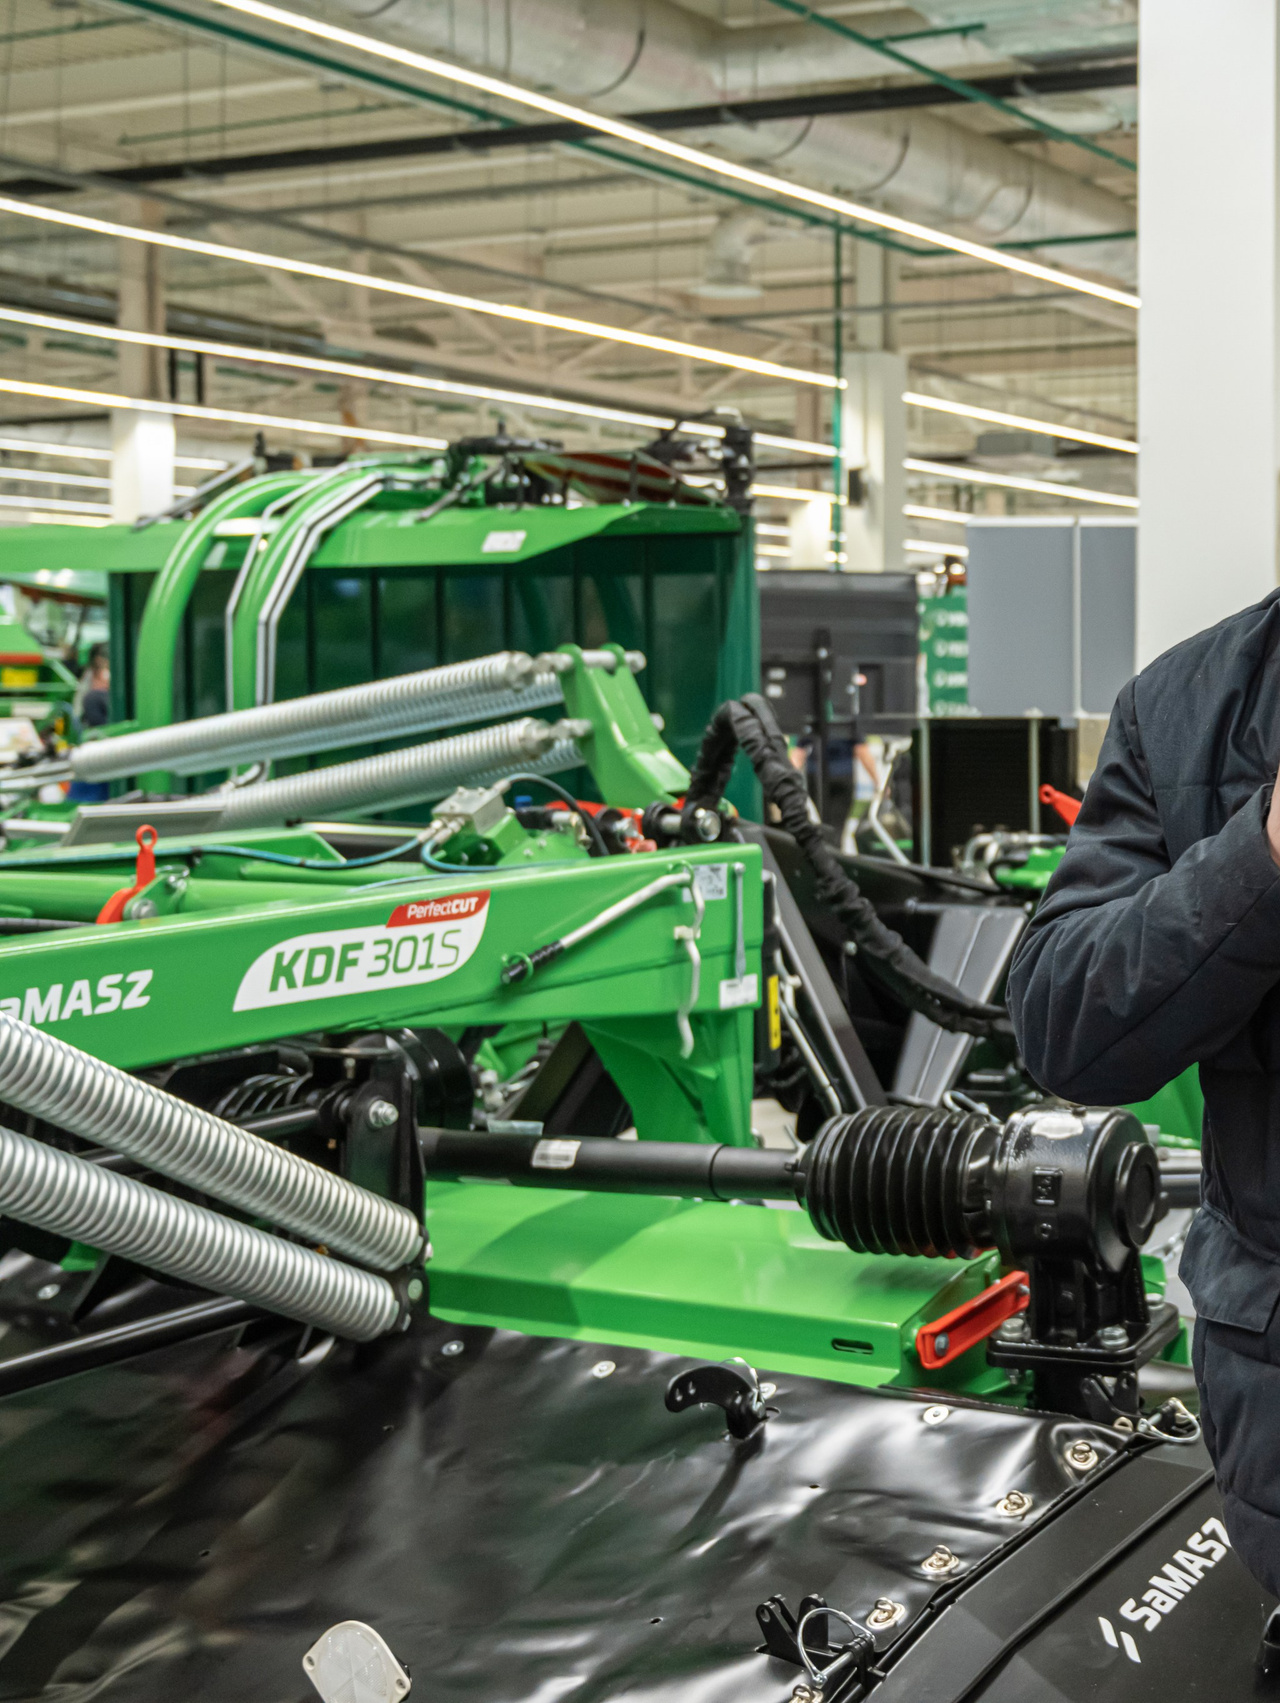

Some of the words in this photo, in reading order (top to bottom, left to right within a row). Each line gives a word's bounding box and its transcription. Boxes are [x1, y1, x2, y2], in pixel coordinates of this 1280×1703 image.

[407, 897, 479, 919] PerfectCUT
[269, 941, 364, 992] KDF
[367, 929, 461, 978] 301S
